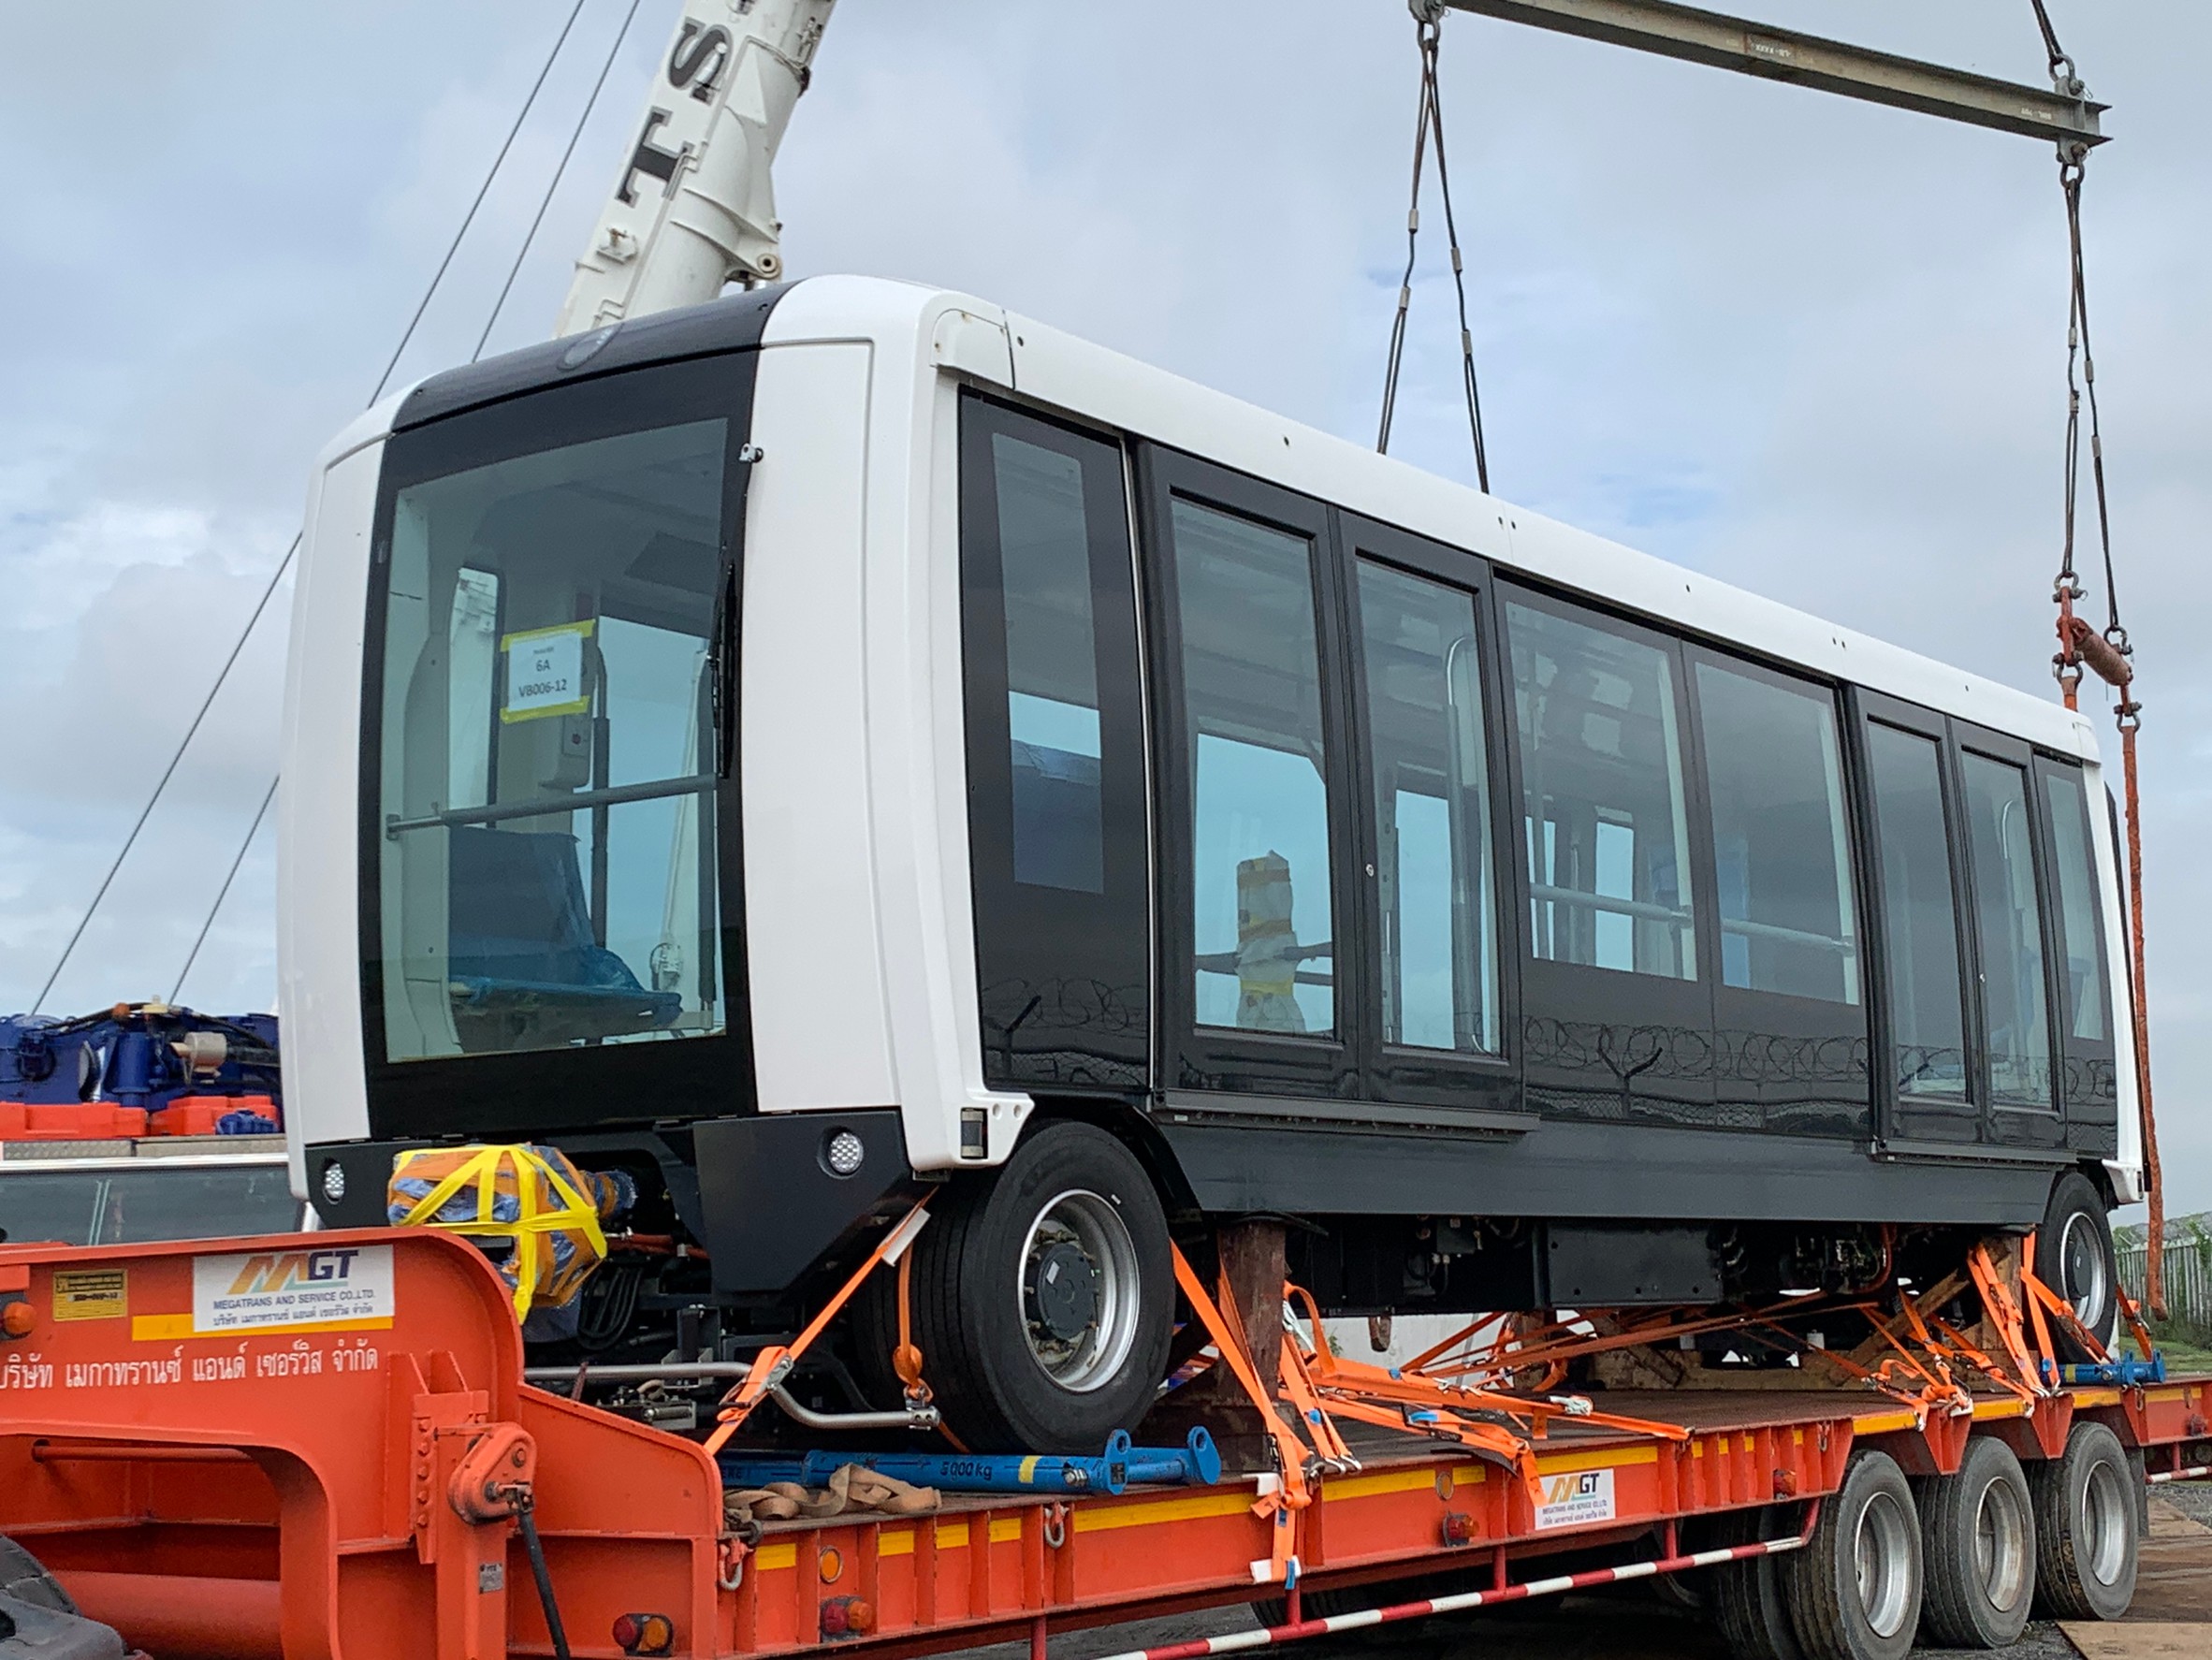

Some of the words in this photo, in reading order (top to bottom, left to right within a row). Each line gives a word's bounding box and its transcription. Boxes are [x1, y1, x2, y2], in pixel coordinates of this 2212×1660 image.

[535, 659, 551, 672] 6A
[518, 678, 568, 697] VB006-12
[226, 1249, 359, 1295] MGT
[213, 1296, 272, 1310] MEGATRANS
[276, 1295, 296, 1305] AND
[298, 1291, 337, 1304] SERVICE
[65, 1345, 183, 1388] เมกาทรานซ์
[193, 1341, 249, 1381] แอนด์
[256, 1338, 323, 1377] เซอร์วิส
[332, 1338, 378, 1372] จำกัด
